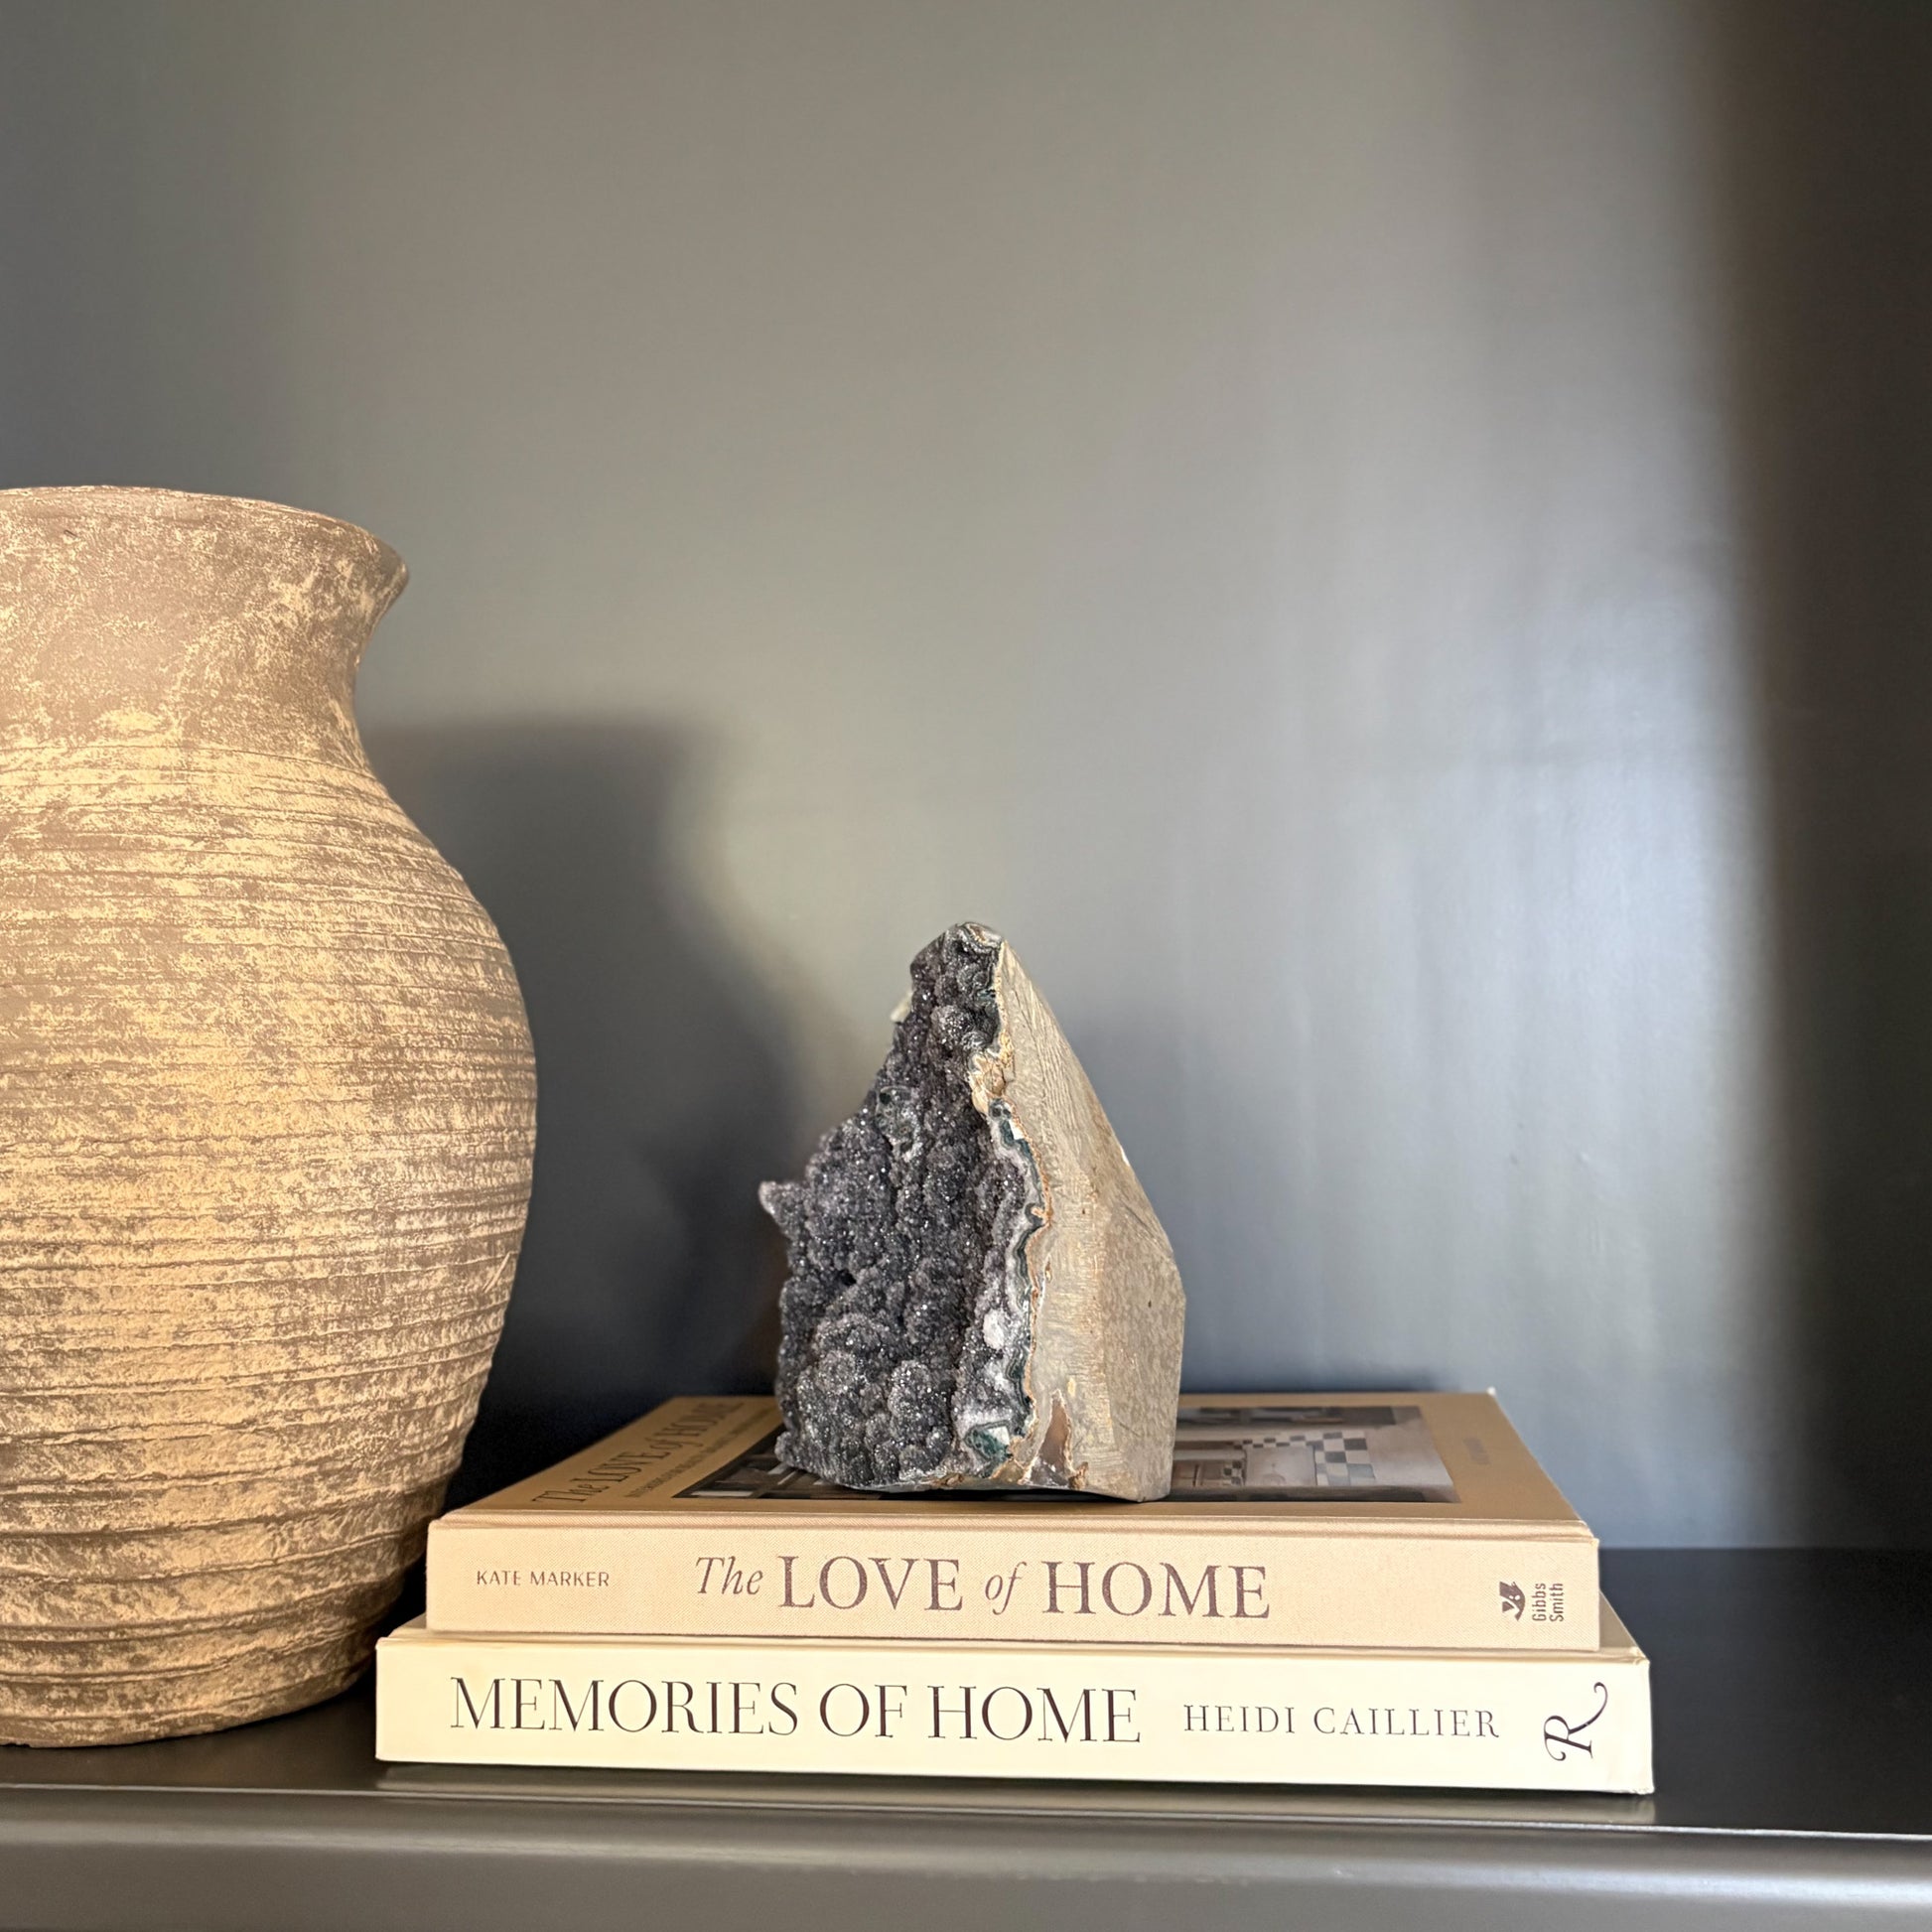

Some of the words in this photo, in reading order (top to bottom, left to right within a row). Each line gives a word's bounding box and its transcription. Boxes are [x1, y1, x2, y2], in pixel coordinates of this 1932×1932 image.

[570, 1451, 671, 1482] LOVE
[531, 1483, 611, 1502] The
[477, 1570, 521, 1587] KATE
[529, 1571, 611, 1587] MARKER
[695, 1556, 764, 1595] The
[777, 1555, 963, 1611] LOVE
[984, 1561, 1028, 1616] of
[1040, 1560, 1271, 1619] HOME
[1531, 1583, 1547, 1622] Gibbs
[1548, 1583, 1565, 1623] Smith
[449, 1676, 798, 1736] MEMORIES
[818, 1683, 908, 1738] OF
[926, 1684, 1141, 1743] HOME
[1182, 1704, 1296, 1734] HEIDI
[1312, 1706, 1500, 1738] CAILLIER
[1543, 1681, 1608, 1762] R
